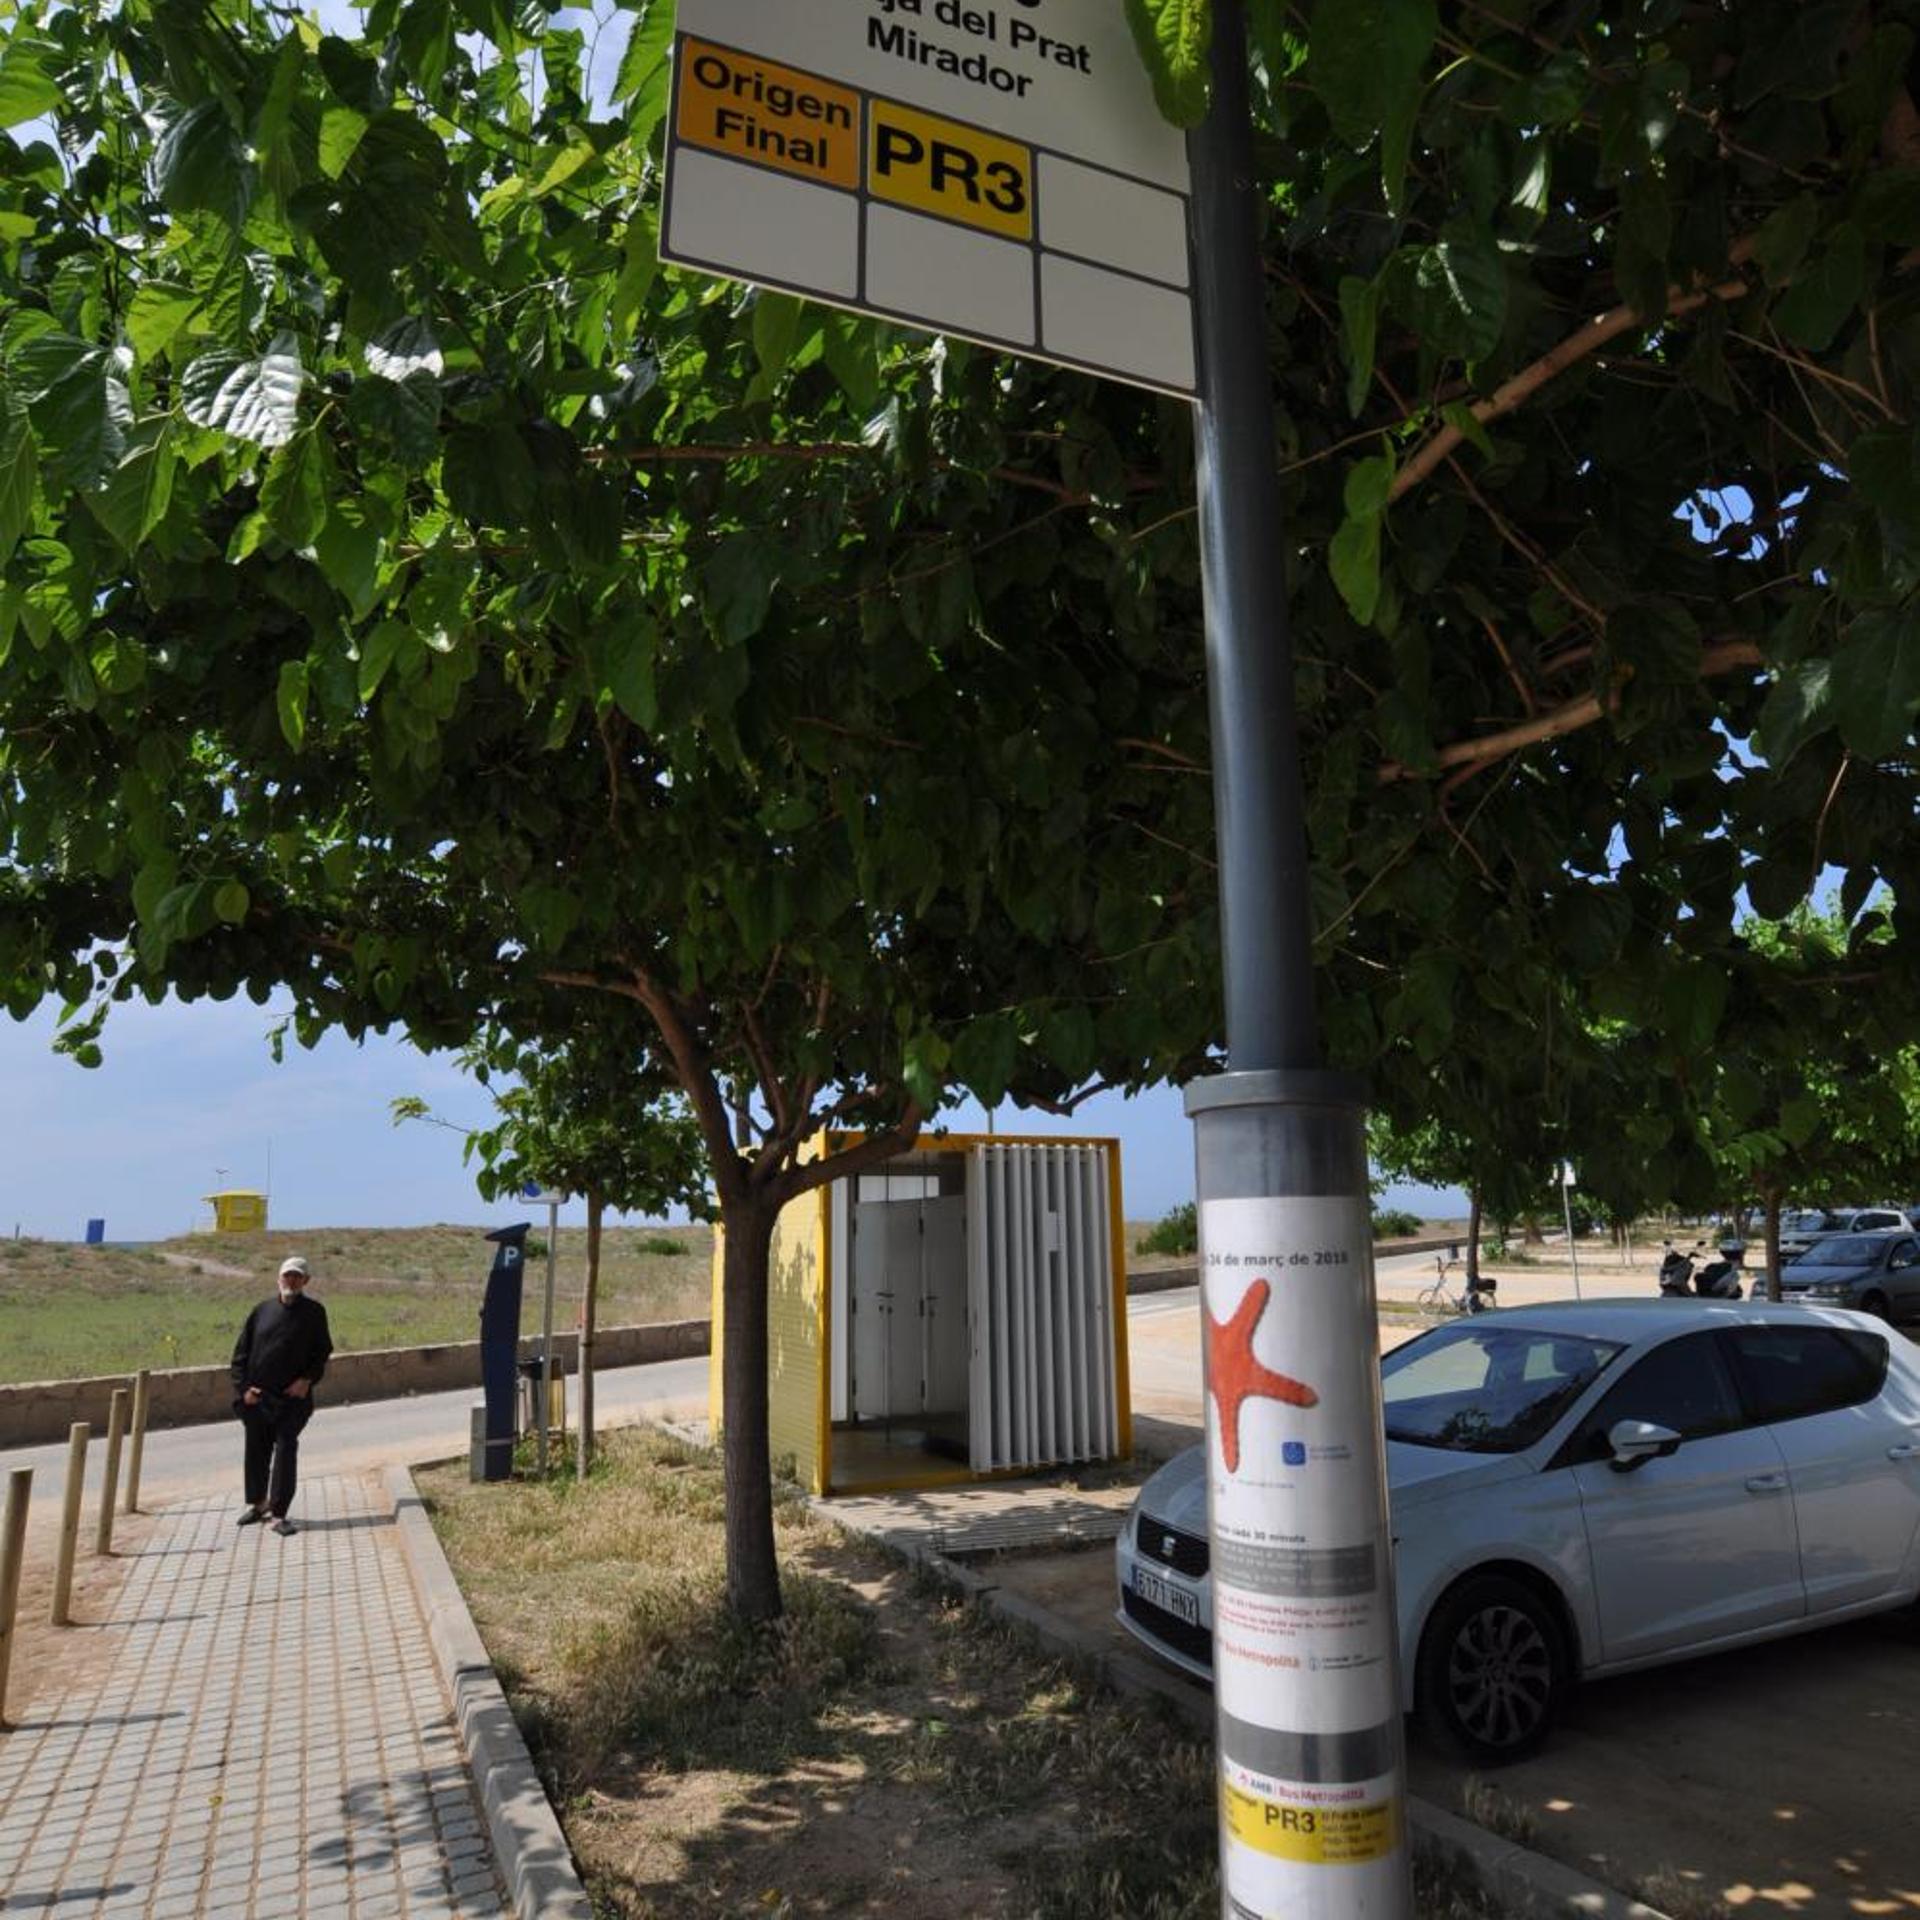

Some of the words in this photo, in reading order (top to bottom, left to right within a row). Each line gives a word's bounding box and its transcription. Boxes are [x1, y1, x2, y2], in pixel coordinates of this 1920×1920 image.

[867, 16, 1033, 97] Mirador
[935, 0, 995, 40] del
[1010, 18, 1091, 74] Prat
[692, 55, 851, 129] Origen
[715, 108, 828, 169] Final
[875, 124, 1027, 214] PR3
[505, 1246, 518, 1267] P
[1224, 1253, 1239, 1266] de
[1244, 1255, 1284, 1268] març
[1289, 1252, 1310, 1266] de
[1264, 1803, 1316, 1833] PR3
